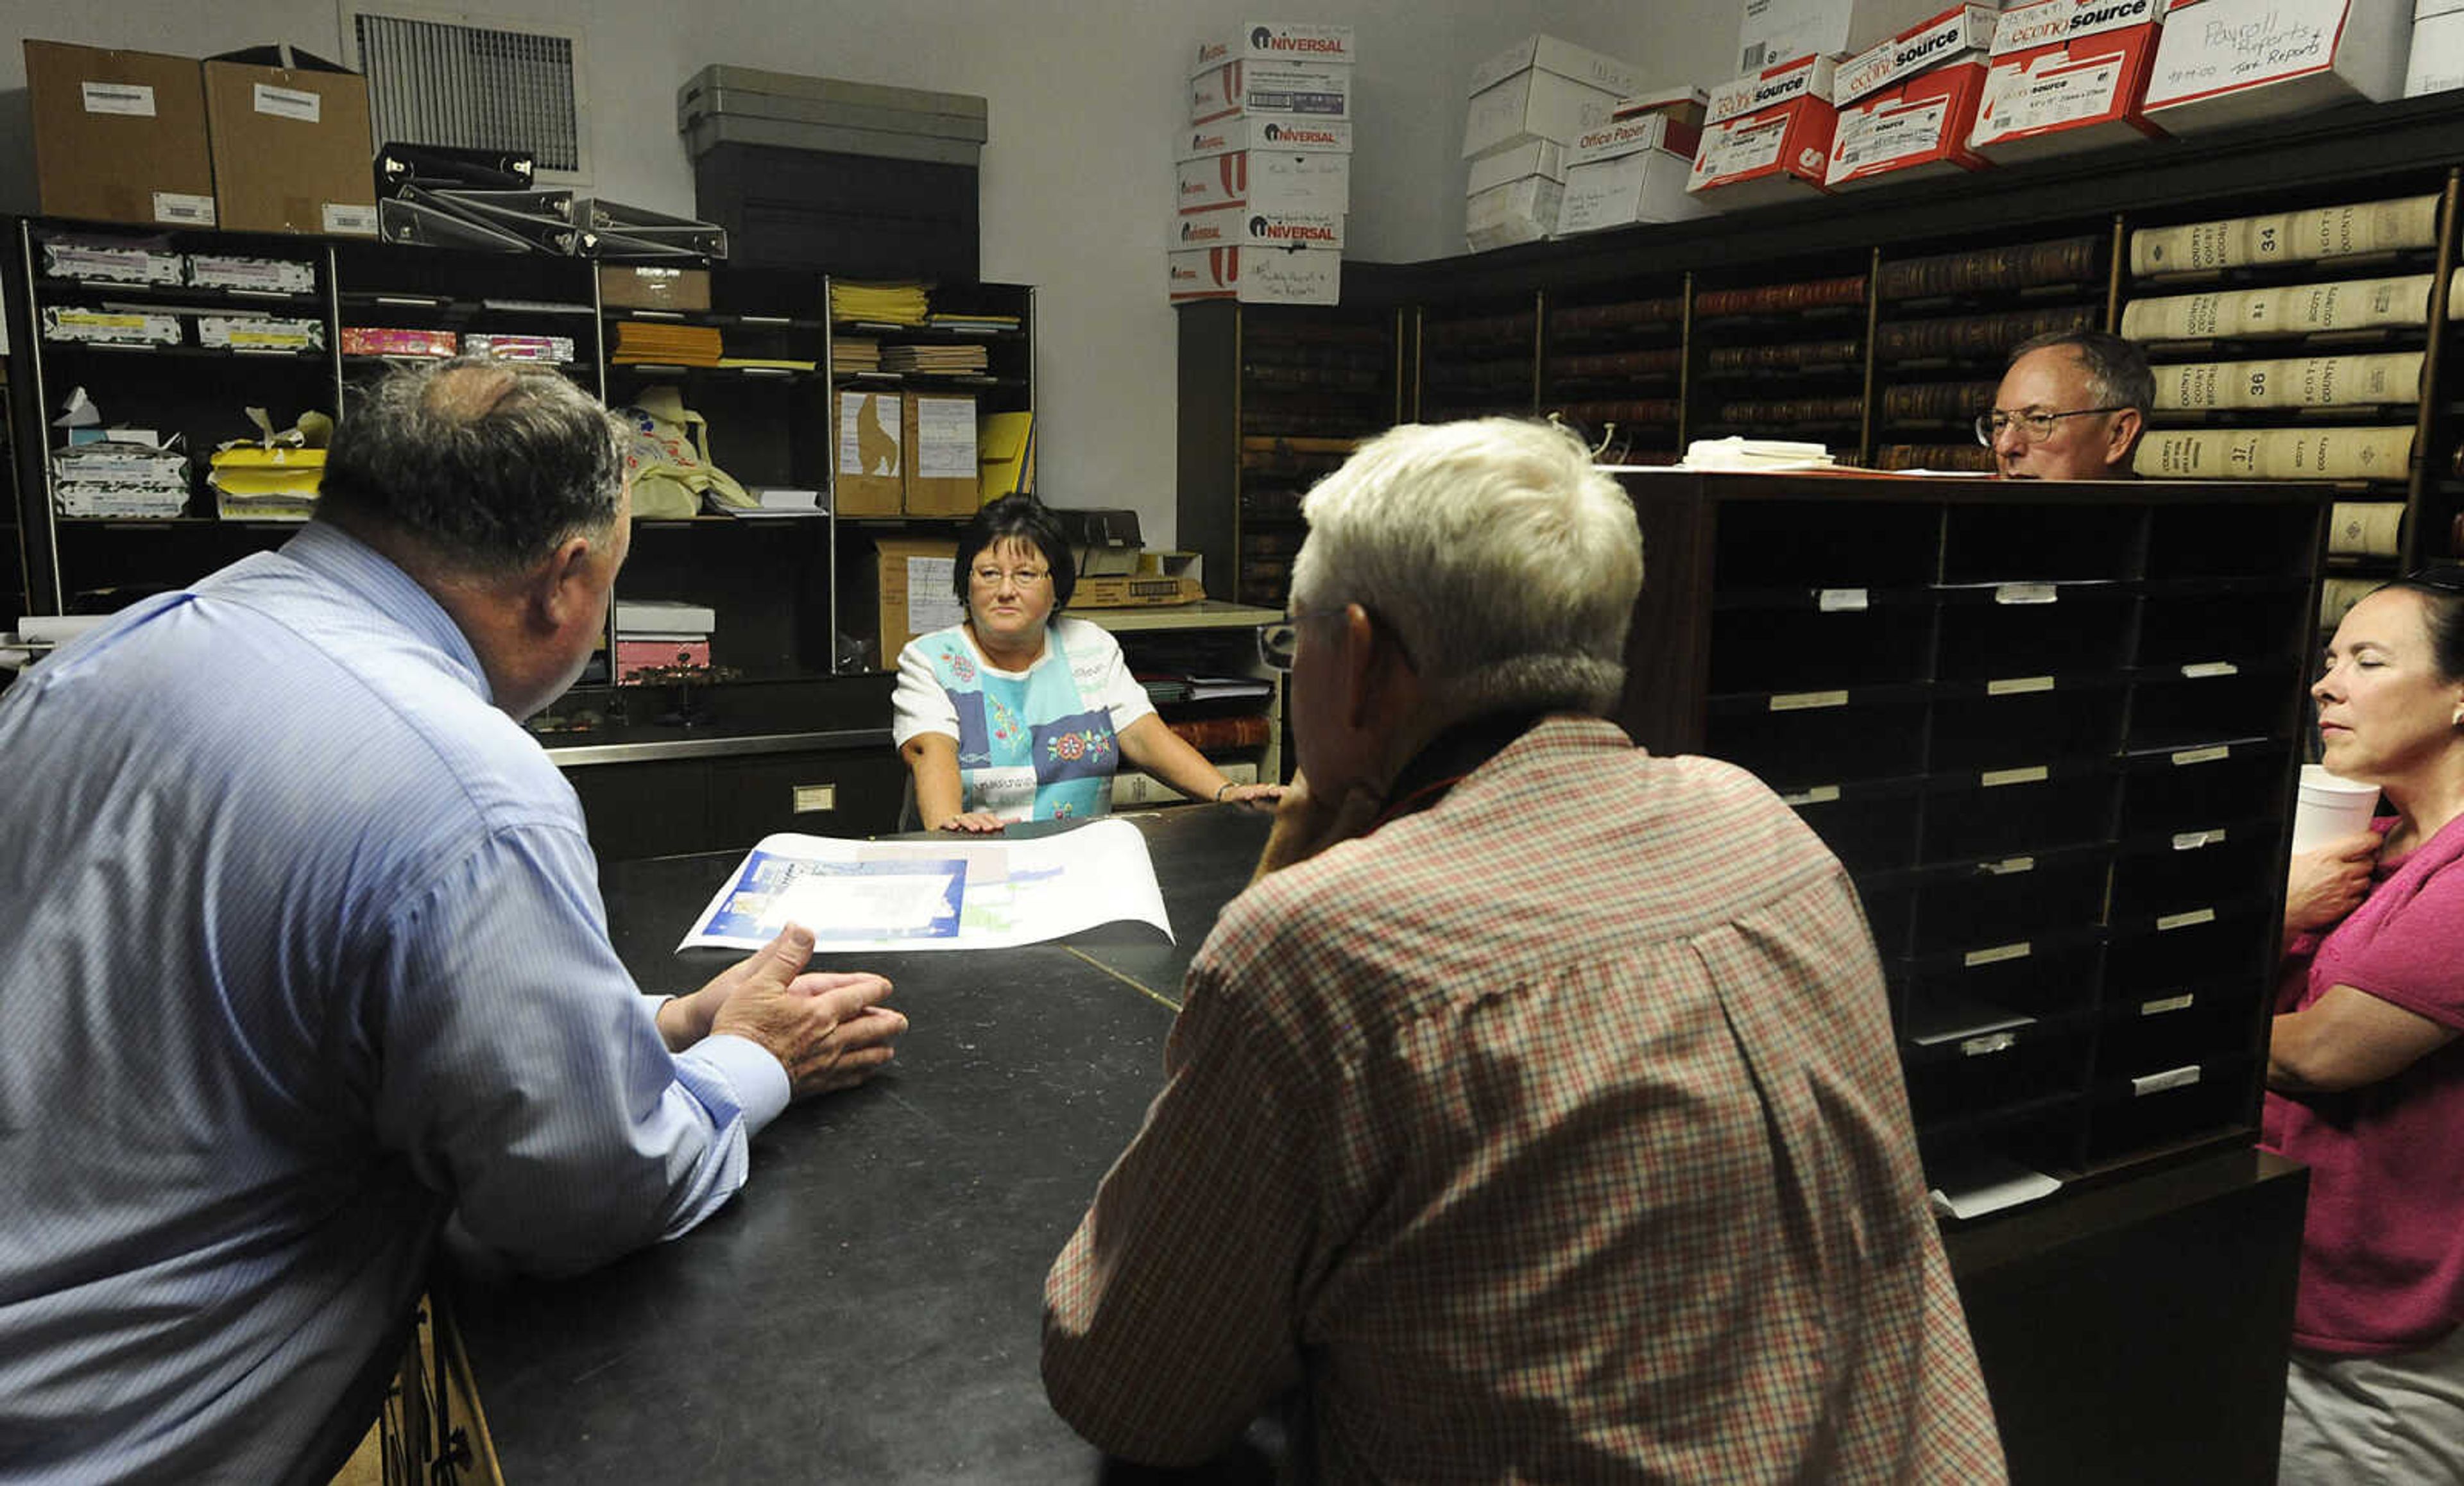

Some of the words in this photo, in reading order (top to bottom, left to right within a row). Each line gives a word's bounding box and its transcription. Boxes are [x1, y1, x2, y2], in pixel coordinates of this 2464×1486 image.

[2205, 12, 2277, 47] Payroll
[1580, 133, 1613, 148] Office
[2261, 228, 2275, 252] 34
[2250, 373, 2265, 396] 36
